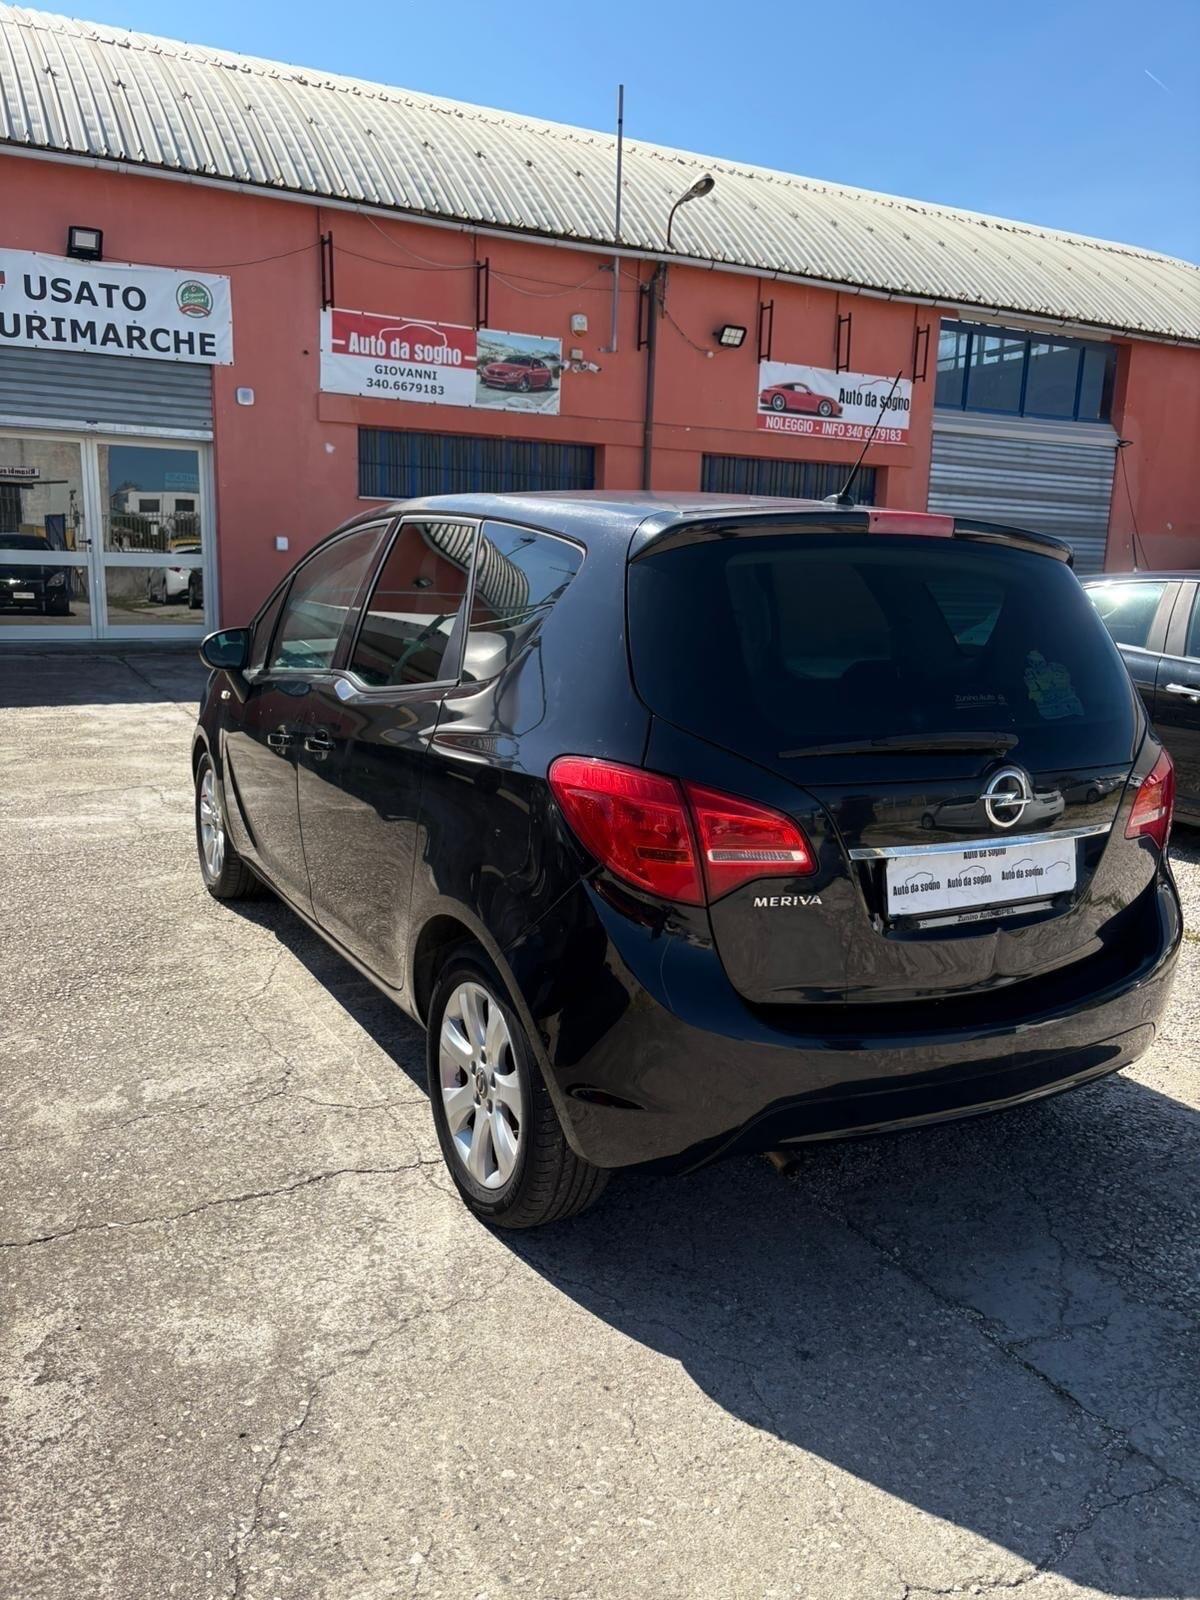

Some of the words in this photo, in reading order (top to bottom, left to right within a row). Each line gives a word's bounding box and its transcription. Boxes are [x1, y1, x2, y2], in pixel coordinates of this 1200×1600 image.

[23, 274, 147, 312] USATO
[349, 332, 386, 357] Auto
[390, 338, 410, 360] da
[414, 345, 462, 366] sogno
[374, 364, 437, 381] GIOVANNI
[366, 378, 445, 395] 340.6679183
[838, 387, 863, 406] Auto
[864, 391, 877, 408] da
[879, 395, 910, 412] sogno
[765, 415, 814, 433] NOLEGGIO
[822, 422, 845, 434] INFO
[846, 424, 863, 438] 340
[947, 877, 962, 889] Auto
[963, 877, 972, 887] da
[972, 874, 992, 886] sogno
[1001, 869, 1016, 881] Auto
[1015, 868, 1025, 879] da
[892, 884, 910, 896] Auto
[910, 883, 920, 893] da
[753, 895, 823, 908] MERIVA
